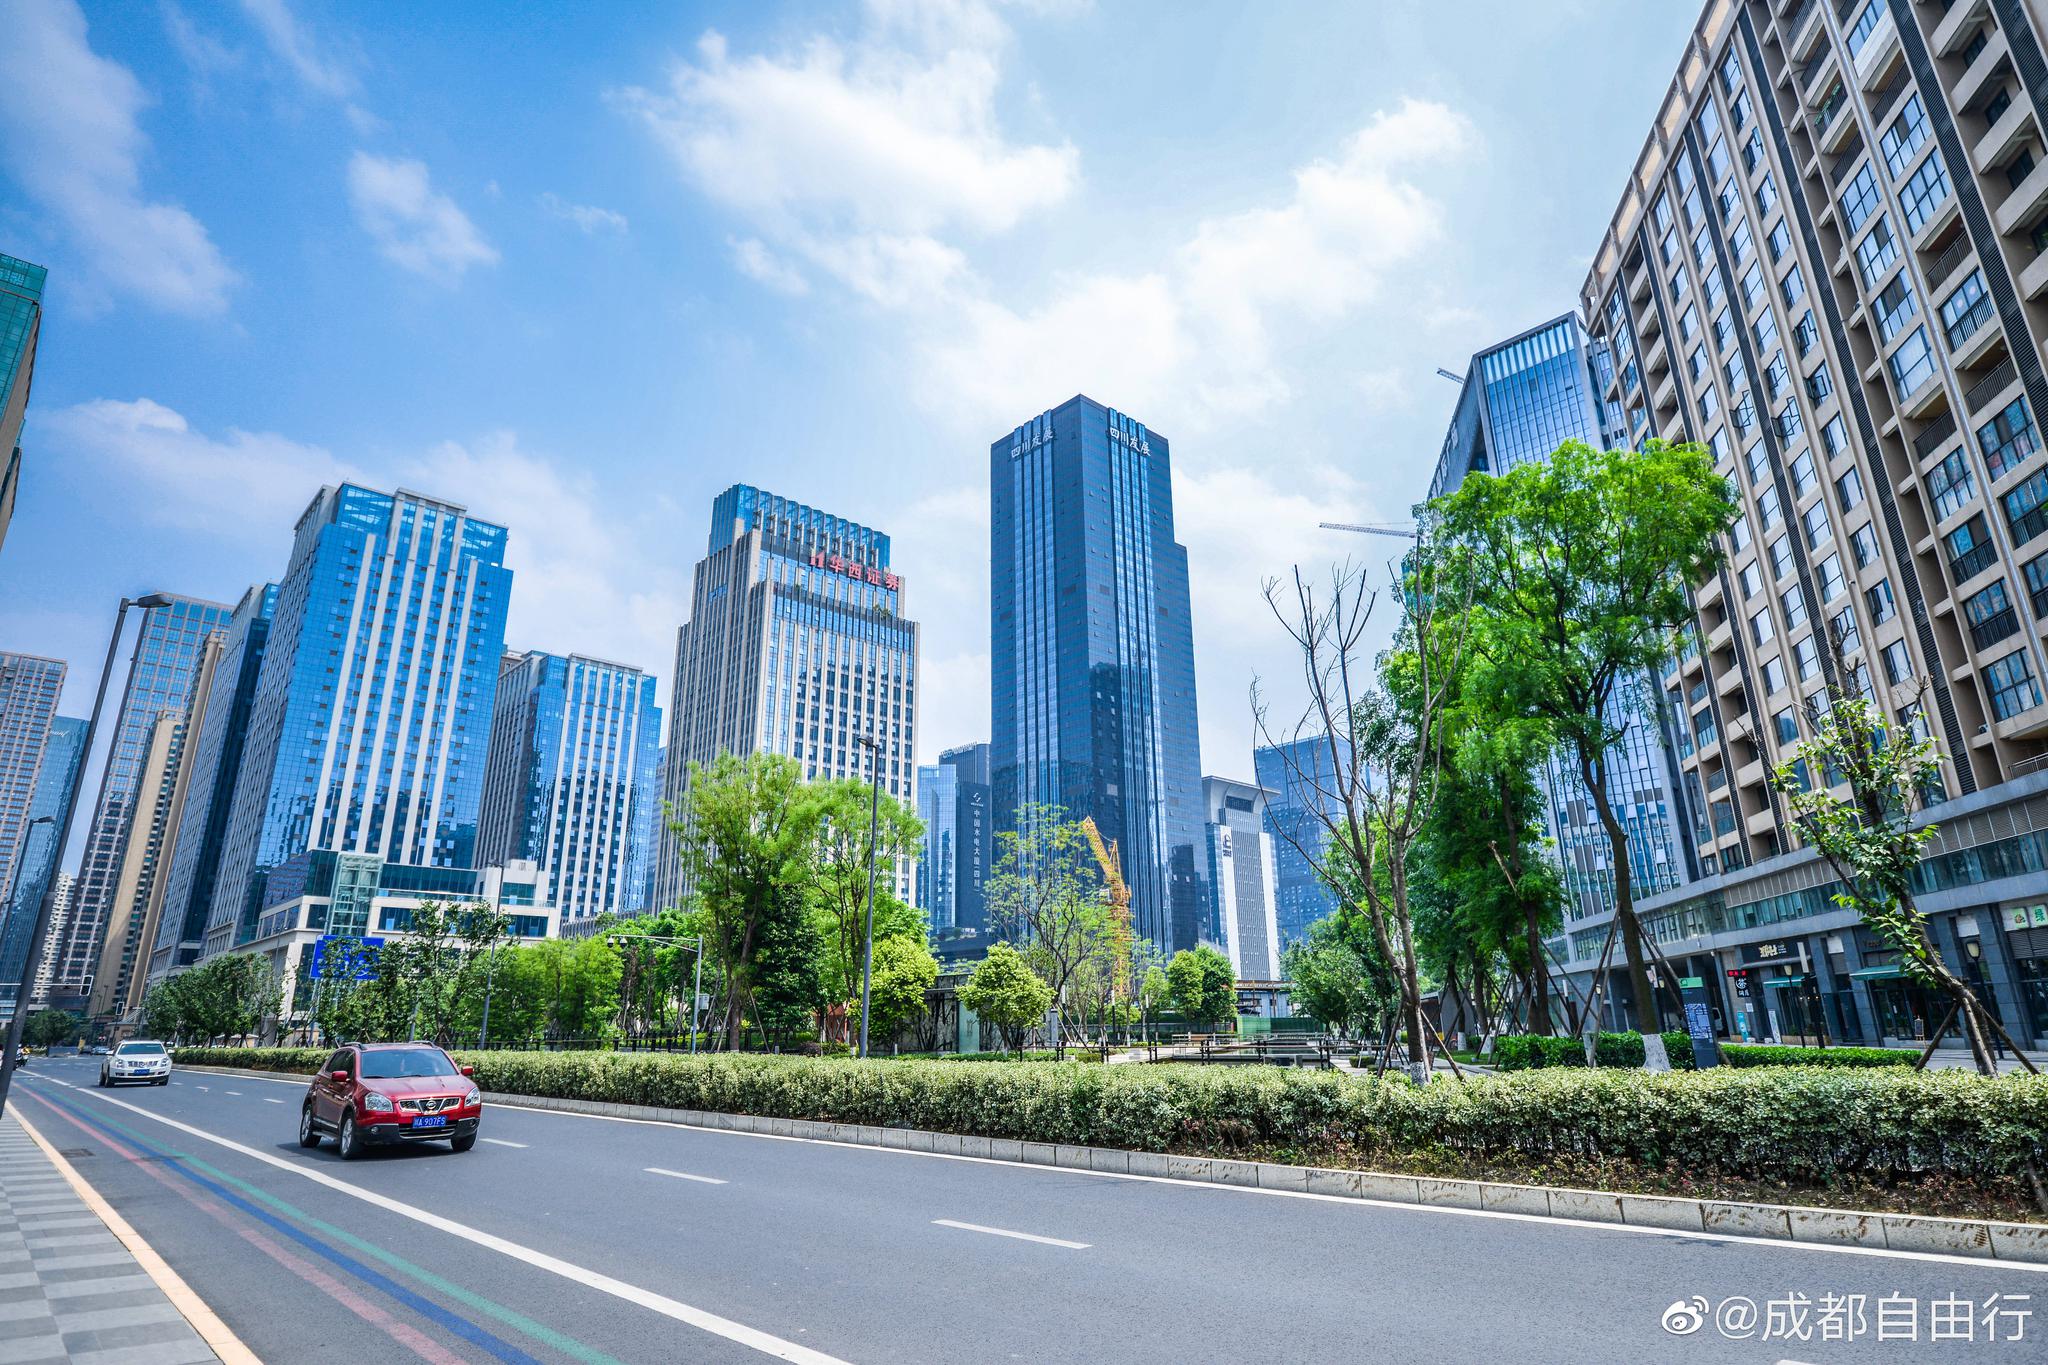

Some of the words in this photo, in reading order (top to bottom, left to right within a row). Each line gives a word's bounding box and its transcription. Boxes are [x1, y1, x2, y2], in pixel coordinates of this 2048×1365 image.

[1011, 426, 1054, 458] 四川发展
[1109, 427, 1152, 457] 四川发展
[829, 554, 899, 590] 华西证券
